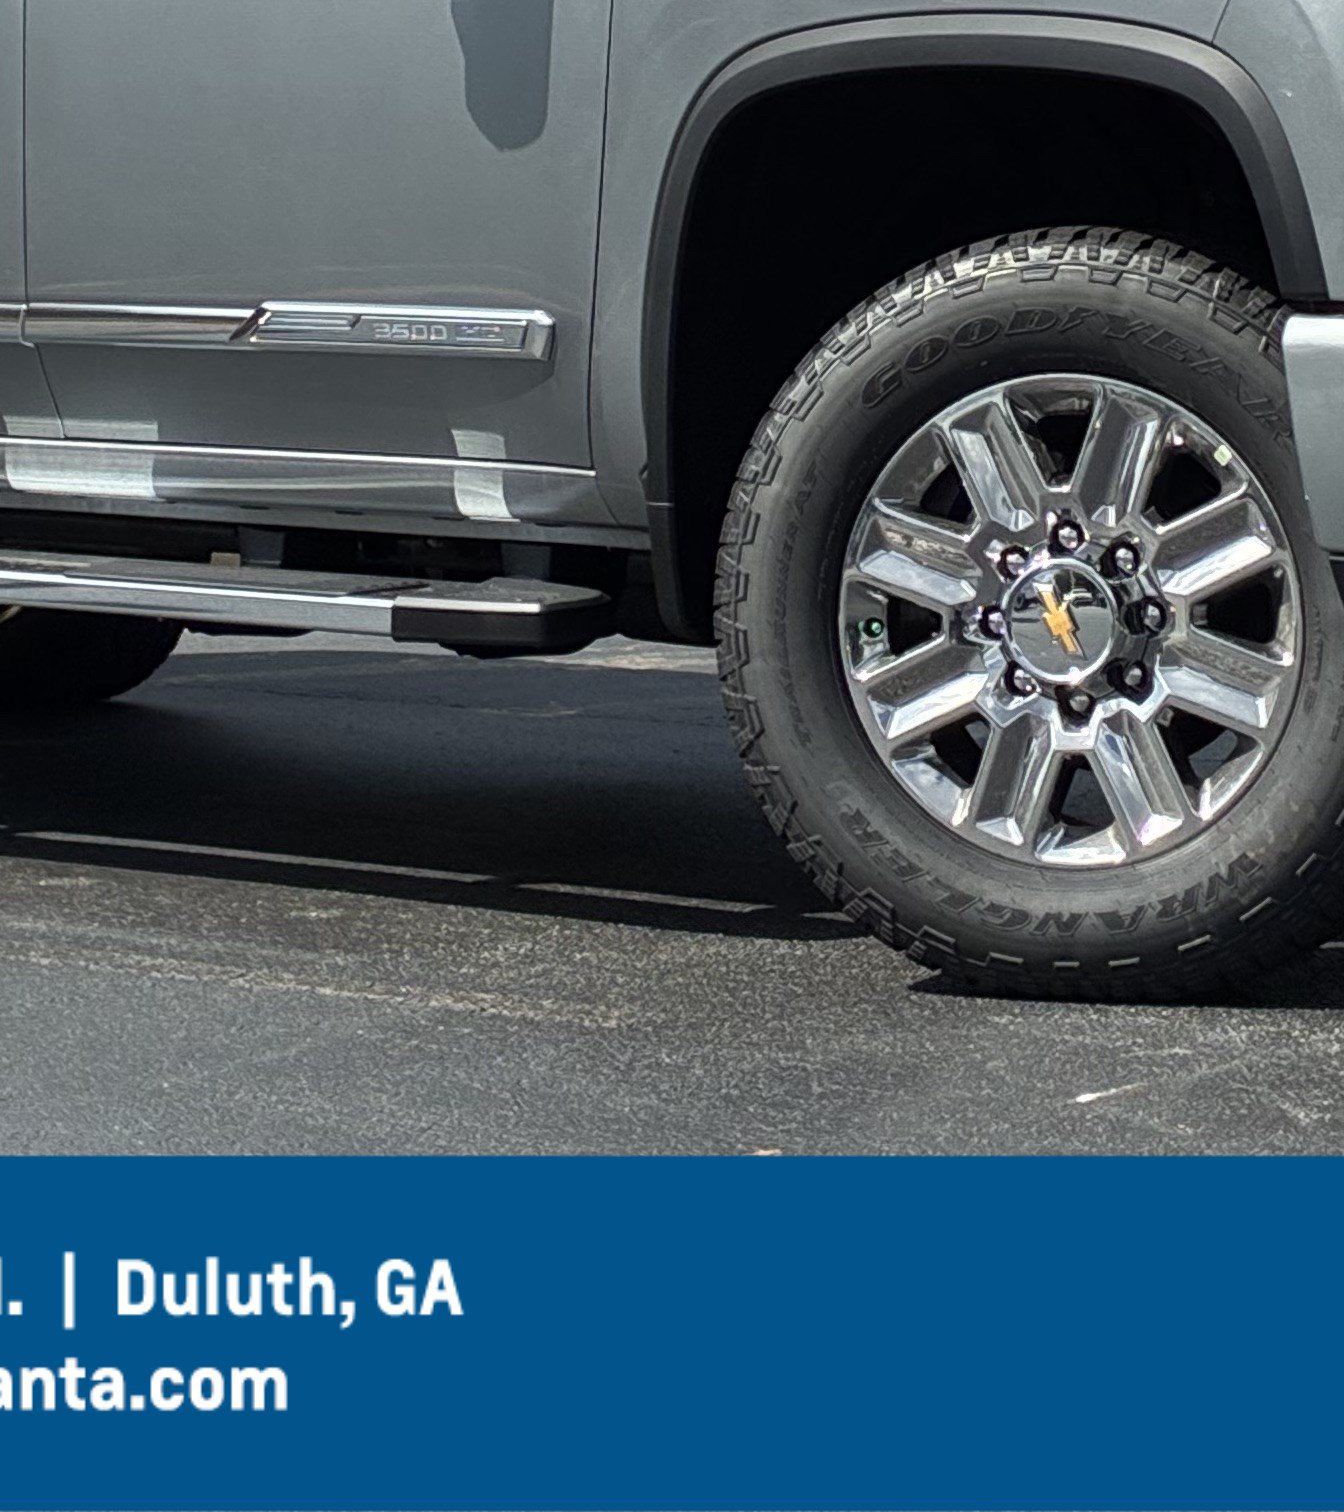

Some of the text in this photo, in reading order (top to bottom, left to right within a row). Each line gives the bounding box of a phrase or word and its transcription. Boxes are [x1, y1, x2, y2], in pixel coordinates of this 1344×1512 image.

[372, 322, 448, 341] 3500
[860, 306, 1294, 446] GOODYEAR
[838, 803, 1264, 938] WRANGLER
